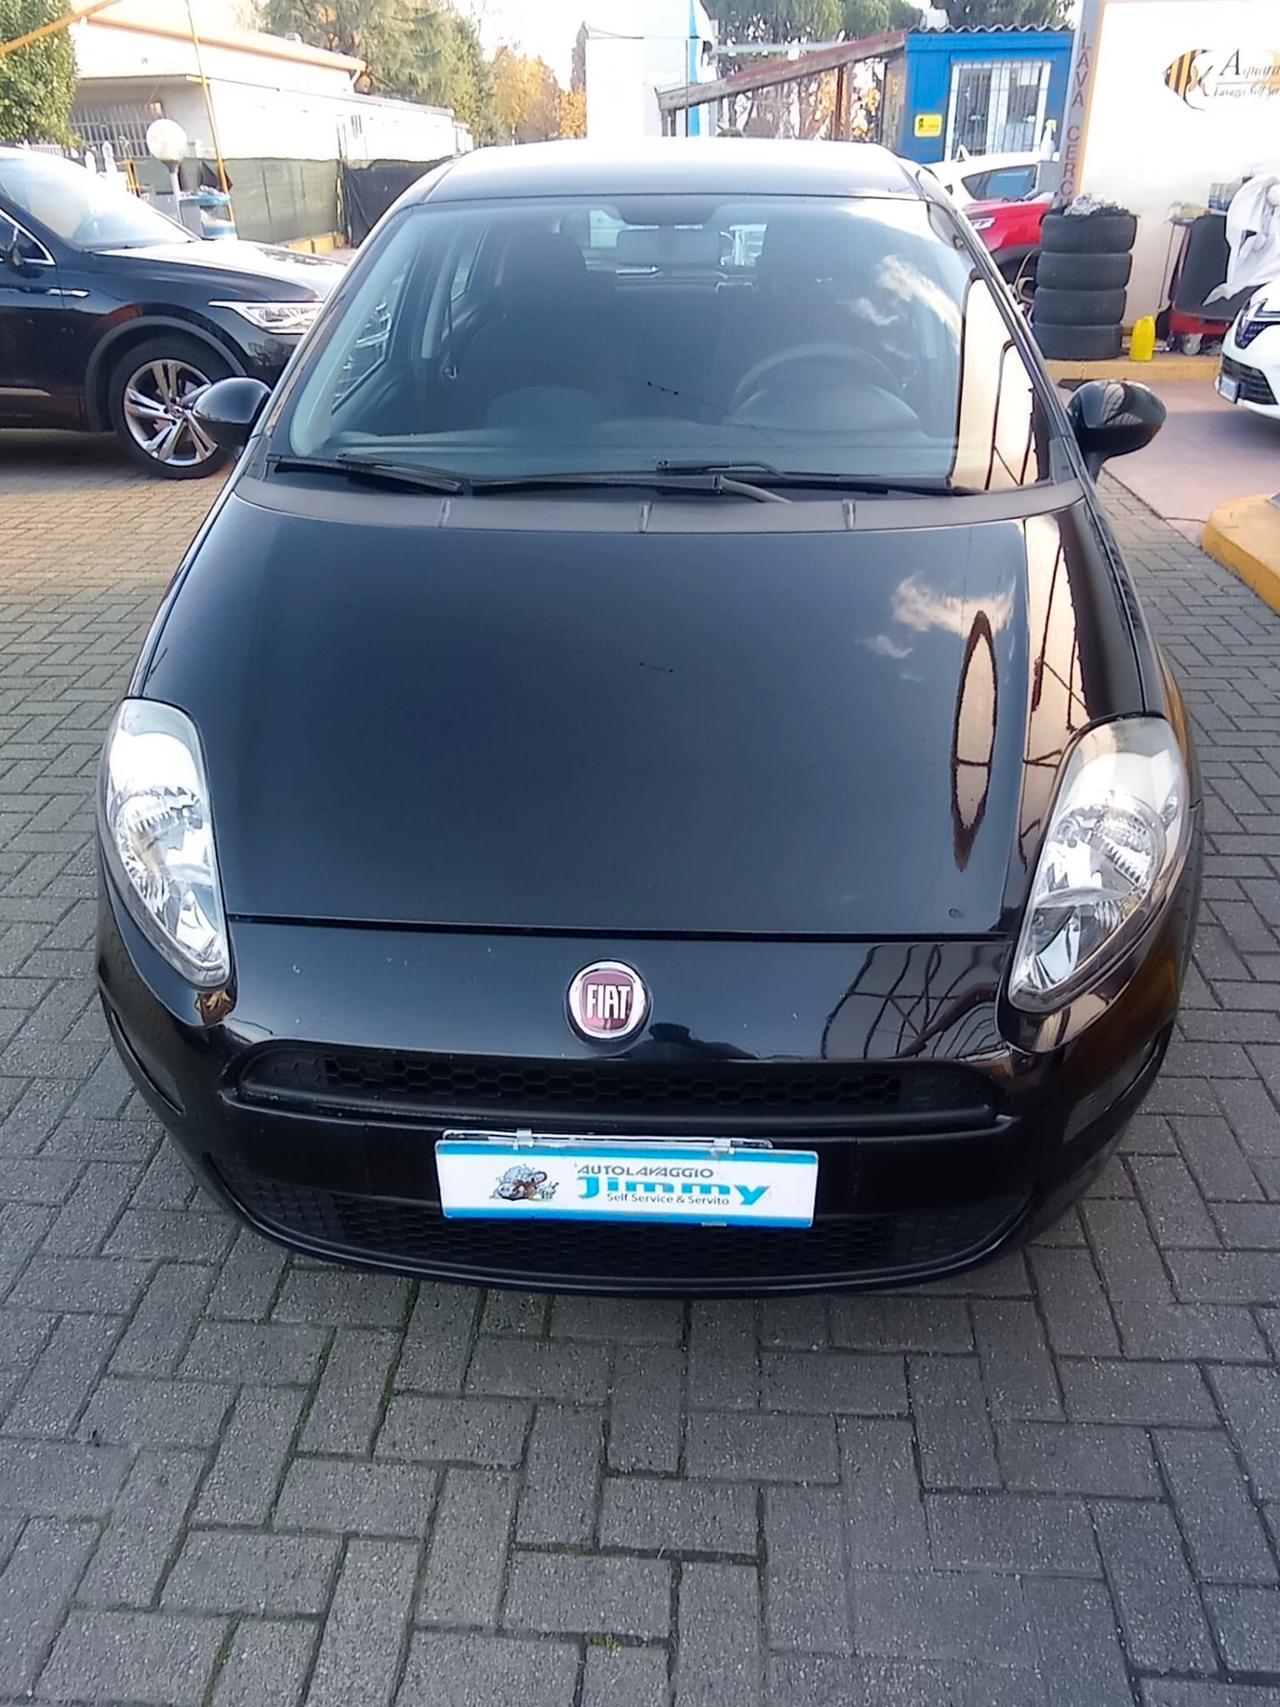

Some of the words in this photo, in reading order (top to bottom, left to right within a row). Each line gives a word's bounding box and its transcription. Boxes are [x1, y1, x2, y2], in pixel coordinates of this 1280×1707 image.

[1071, 31, 1092, 107] LAVA
[586, 983, 631, 1020] FIAT
[577, 1164, 714, 1178] AUTOLAVAGGIO
[576, 1175, 770, 1206] Jimmy
[606, 1193, 628, 1202] Self
[631, 1193, 674, 1204] Service
[676, 1195, 685, 1204] &
[687, 1195, 730, 1206] Servito
